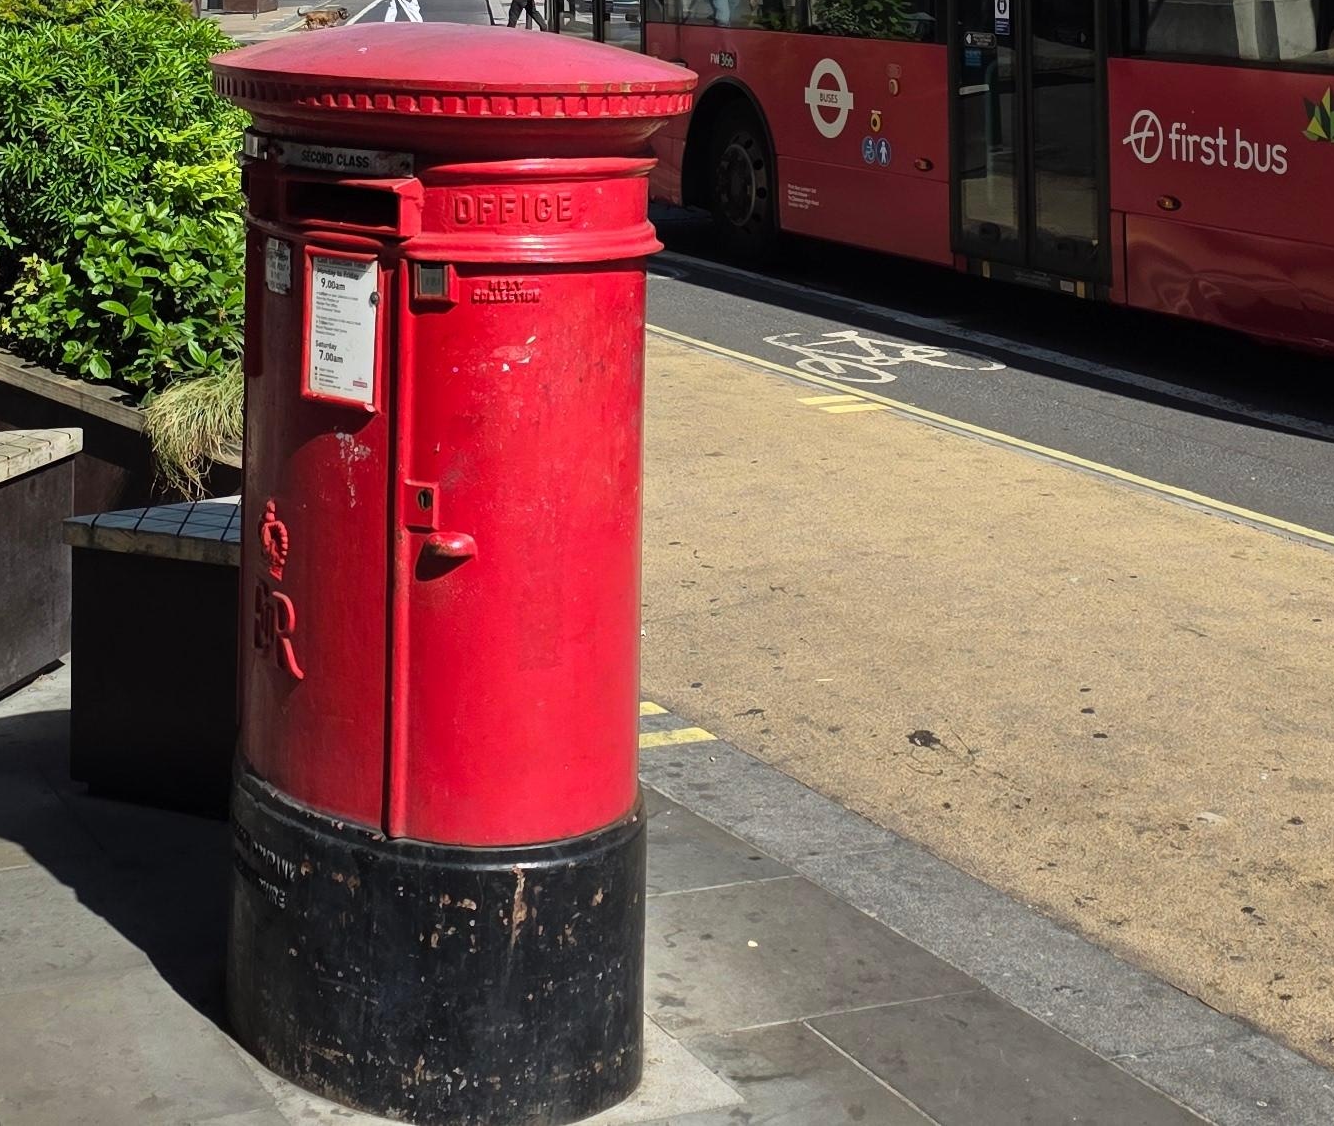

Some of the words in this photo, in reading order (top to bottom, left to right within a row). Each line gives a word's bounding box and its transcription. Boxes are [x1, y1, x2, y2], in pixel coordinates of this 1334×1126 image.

[819, 89, 839, 105] BUSES
[1168, 121, 1228, 167] first
[1233, 128, 1288, 175] bus
[300, 149, 334, 165] SECOND
[336, 153, 370, 169] CLASS
[453, 192, 574, 226] OFFICE
[320, 277, 346, 291] 9.00am
[470, 288, 541, 305] COLLECTION
[315, 339, 337, 352] Saturday
[318, 349, 344, 364] 7.00am
